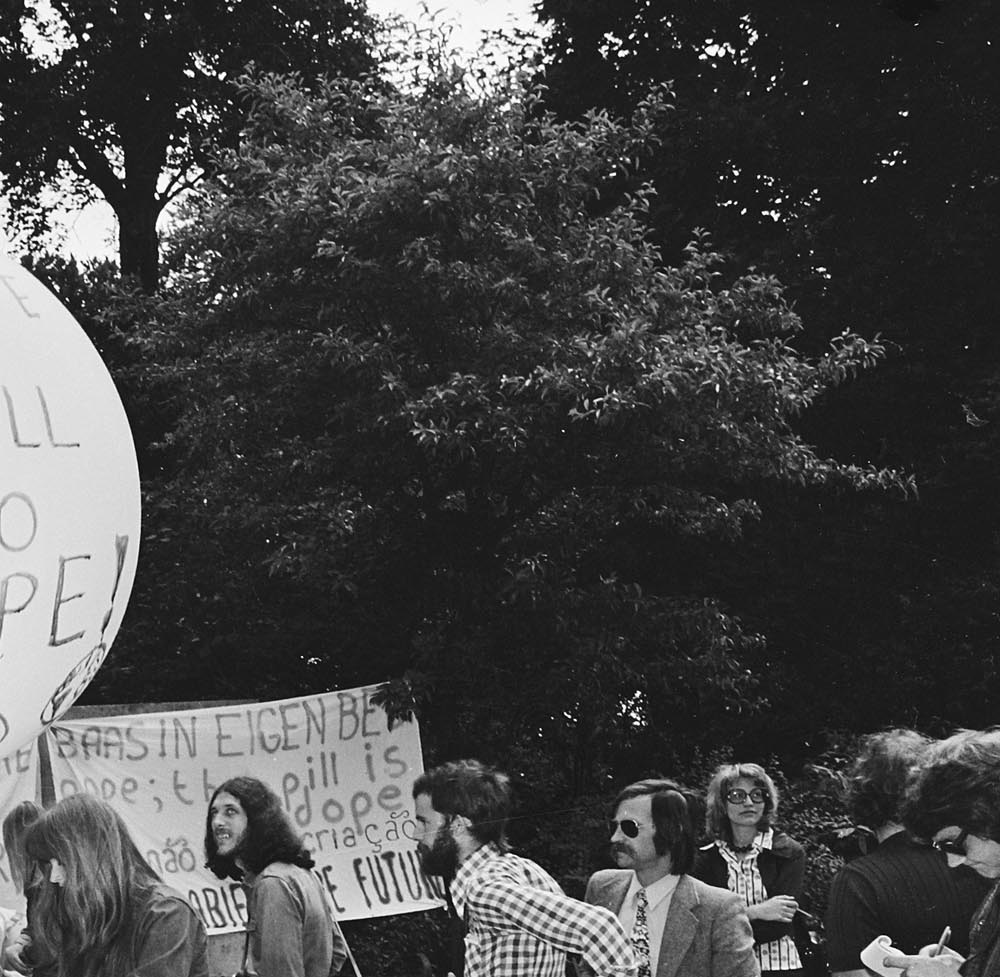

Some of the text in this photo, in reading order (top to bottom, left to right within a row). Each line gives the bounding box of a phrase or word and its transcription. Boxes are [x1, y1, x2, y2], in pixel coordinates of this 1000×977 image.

[54, 722, 149, 761] BAAS
[158, 716, 198, 759] IN
[216, 698, 326, 758] EIGEN
[337, 689, 402, 740] BE
[283, 751, 339, 812] pill
[364, 742, 408, 783] is
[294, 784, 403, 835] dope
